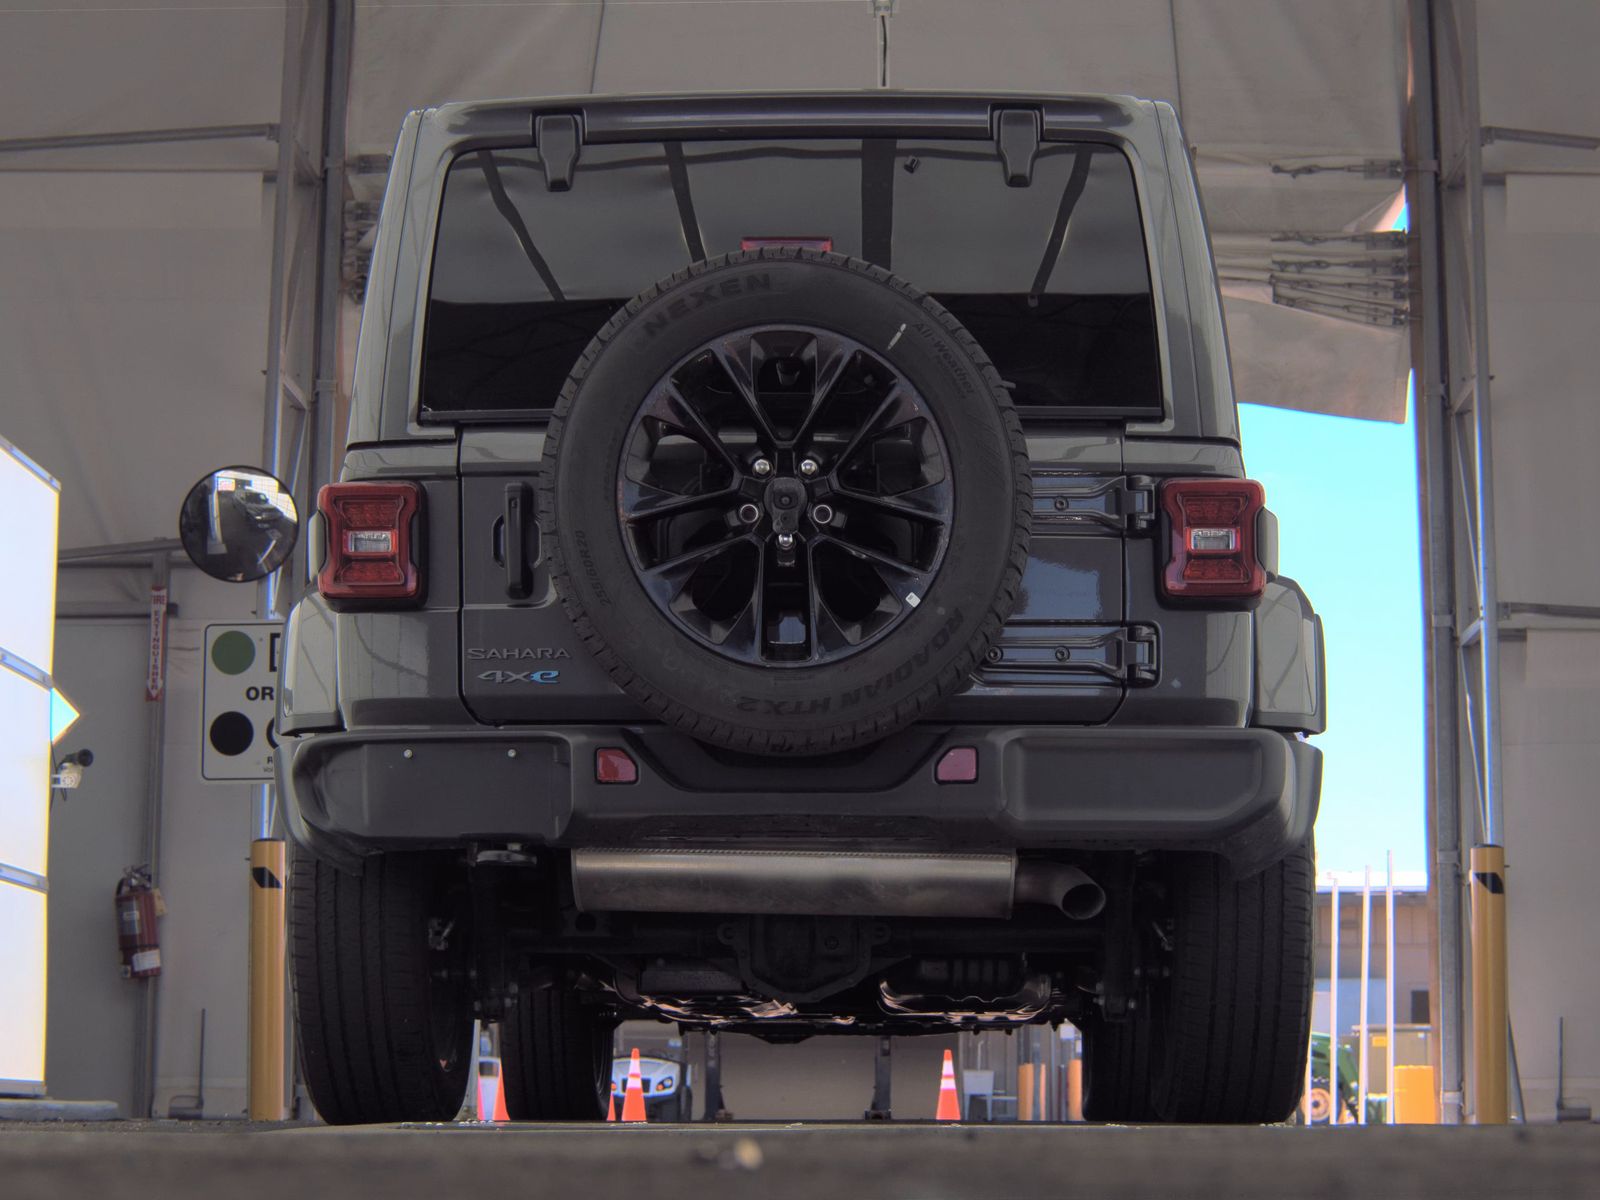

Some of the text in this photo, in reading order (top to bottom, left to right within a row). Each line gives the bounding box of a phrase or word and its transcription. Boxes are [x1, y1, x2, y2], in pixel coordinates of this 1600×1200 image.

[642, 273, 770, 337] NEXEN
[151, 608, 161, 690] EXTINGUISHER
[466, 647, 571, 660] SAHARA
[246, 686, 275, 701] OR
[736, 696, 831, 716] HTX2
